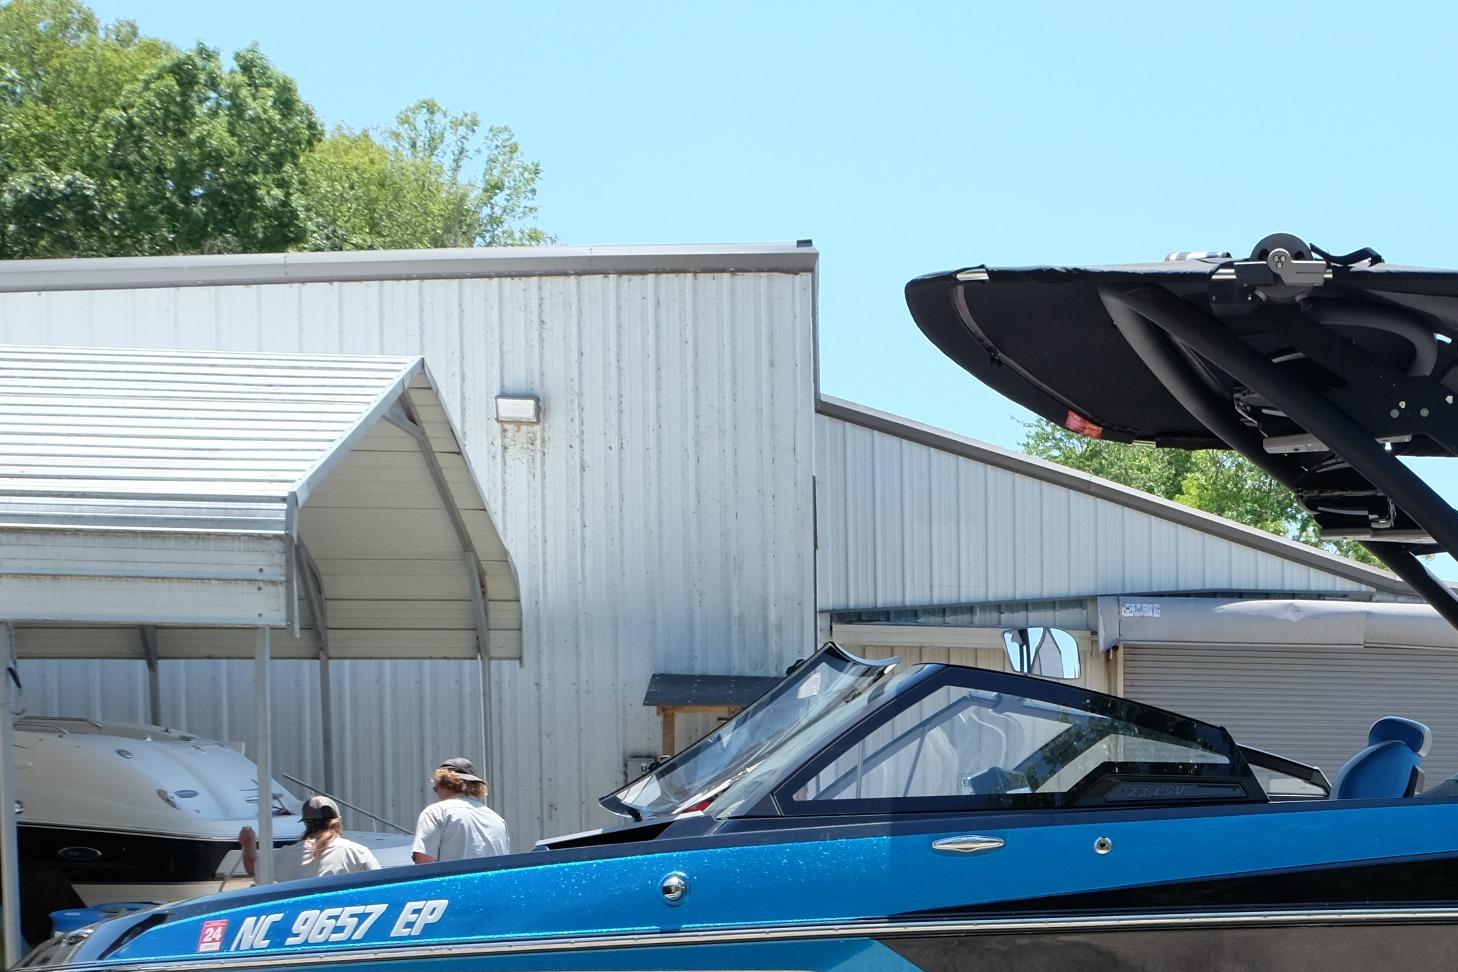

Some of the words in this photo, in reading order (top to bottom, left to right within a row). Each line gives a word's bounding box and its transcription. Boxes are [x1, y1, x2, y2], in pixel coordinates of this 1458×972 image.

[202, 926, 223, 943] 24
[231, 913, 284, 951] NC
[285, 904, 389, 946] 9657
[390, 899, 449, 938] EP
